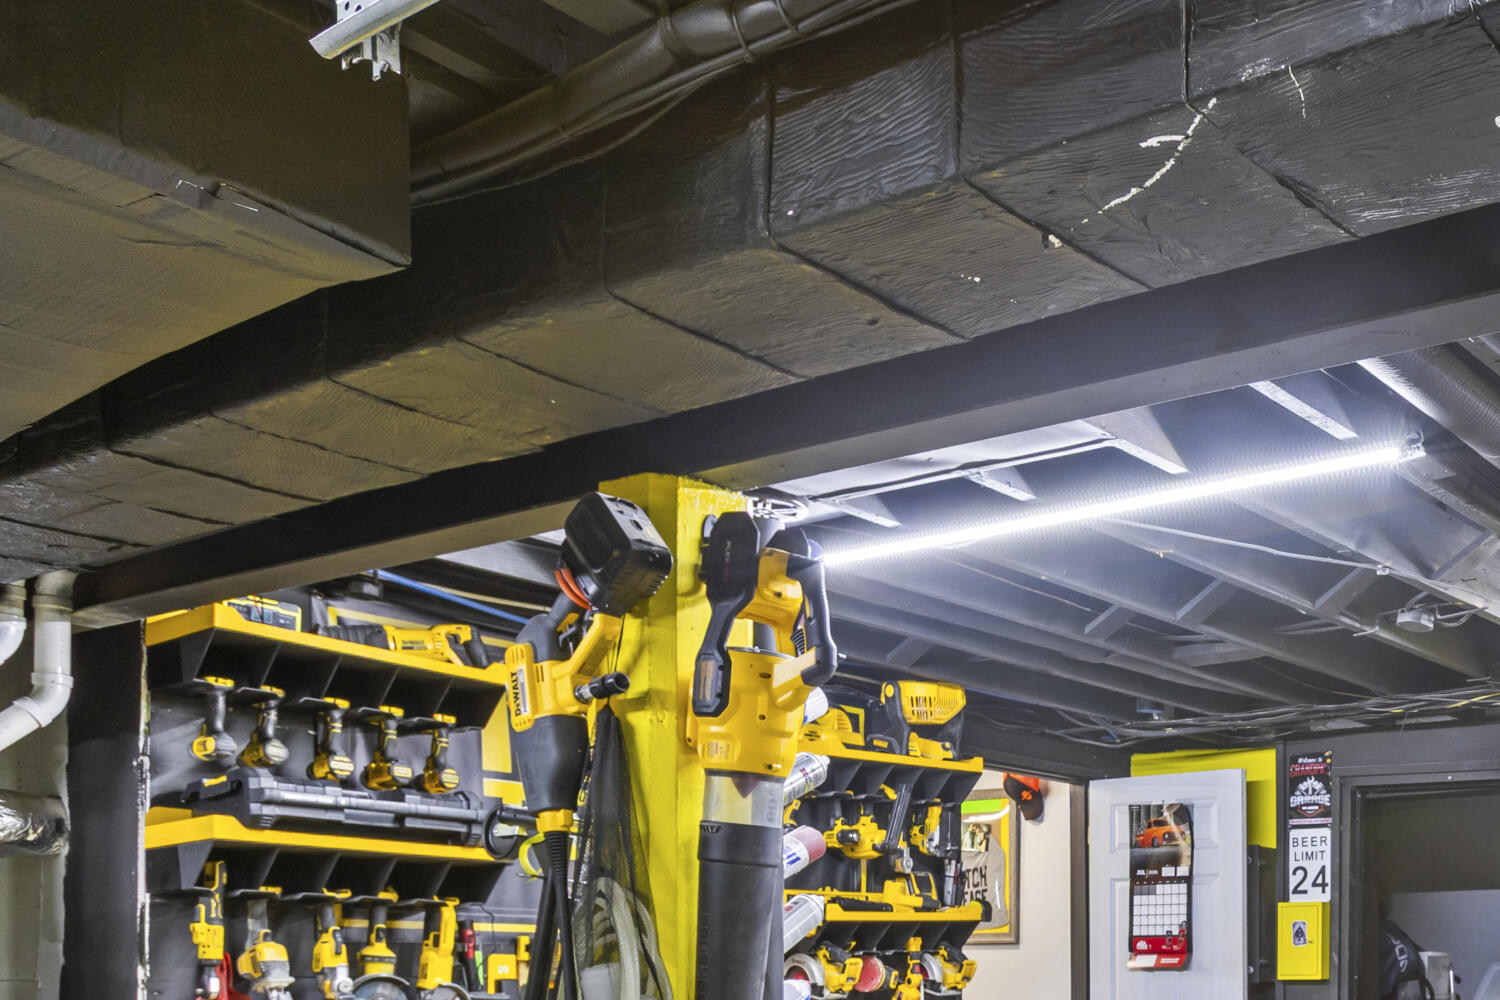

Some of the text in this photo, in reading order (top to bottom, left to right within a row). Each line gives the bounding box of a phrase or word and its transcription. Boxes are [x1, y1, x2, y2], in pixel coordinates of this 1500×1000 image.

[1290, 794, 1331, 808] GARAGE
[1292, 836, 1328, 847] BEER
[1294, 851, 1325, 861] LIMIT
[1291, 865, 1329, 895] 24
